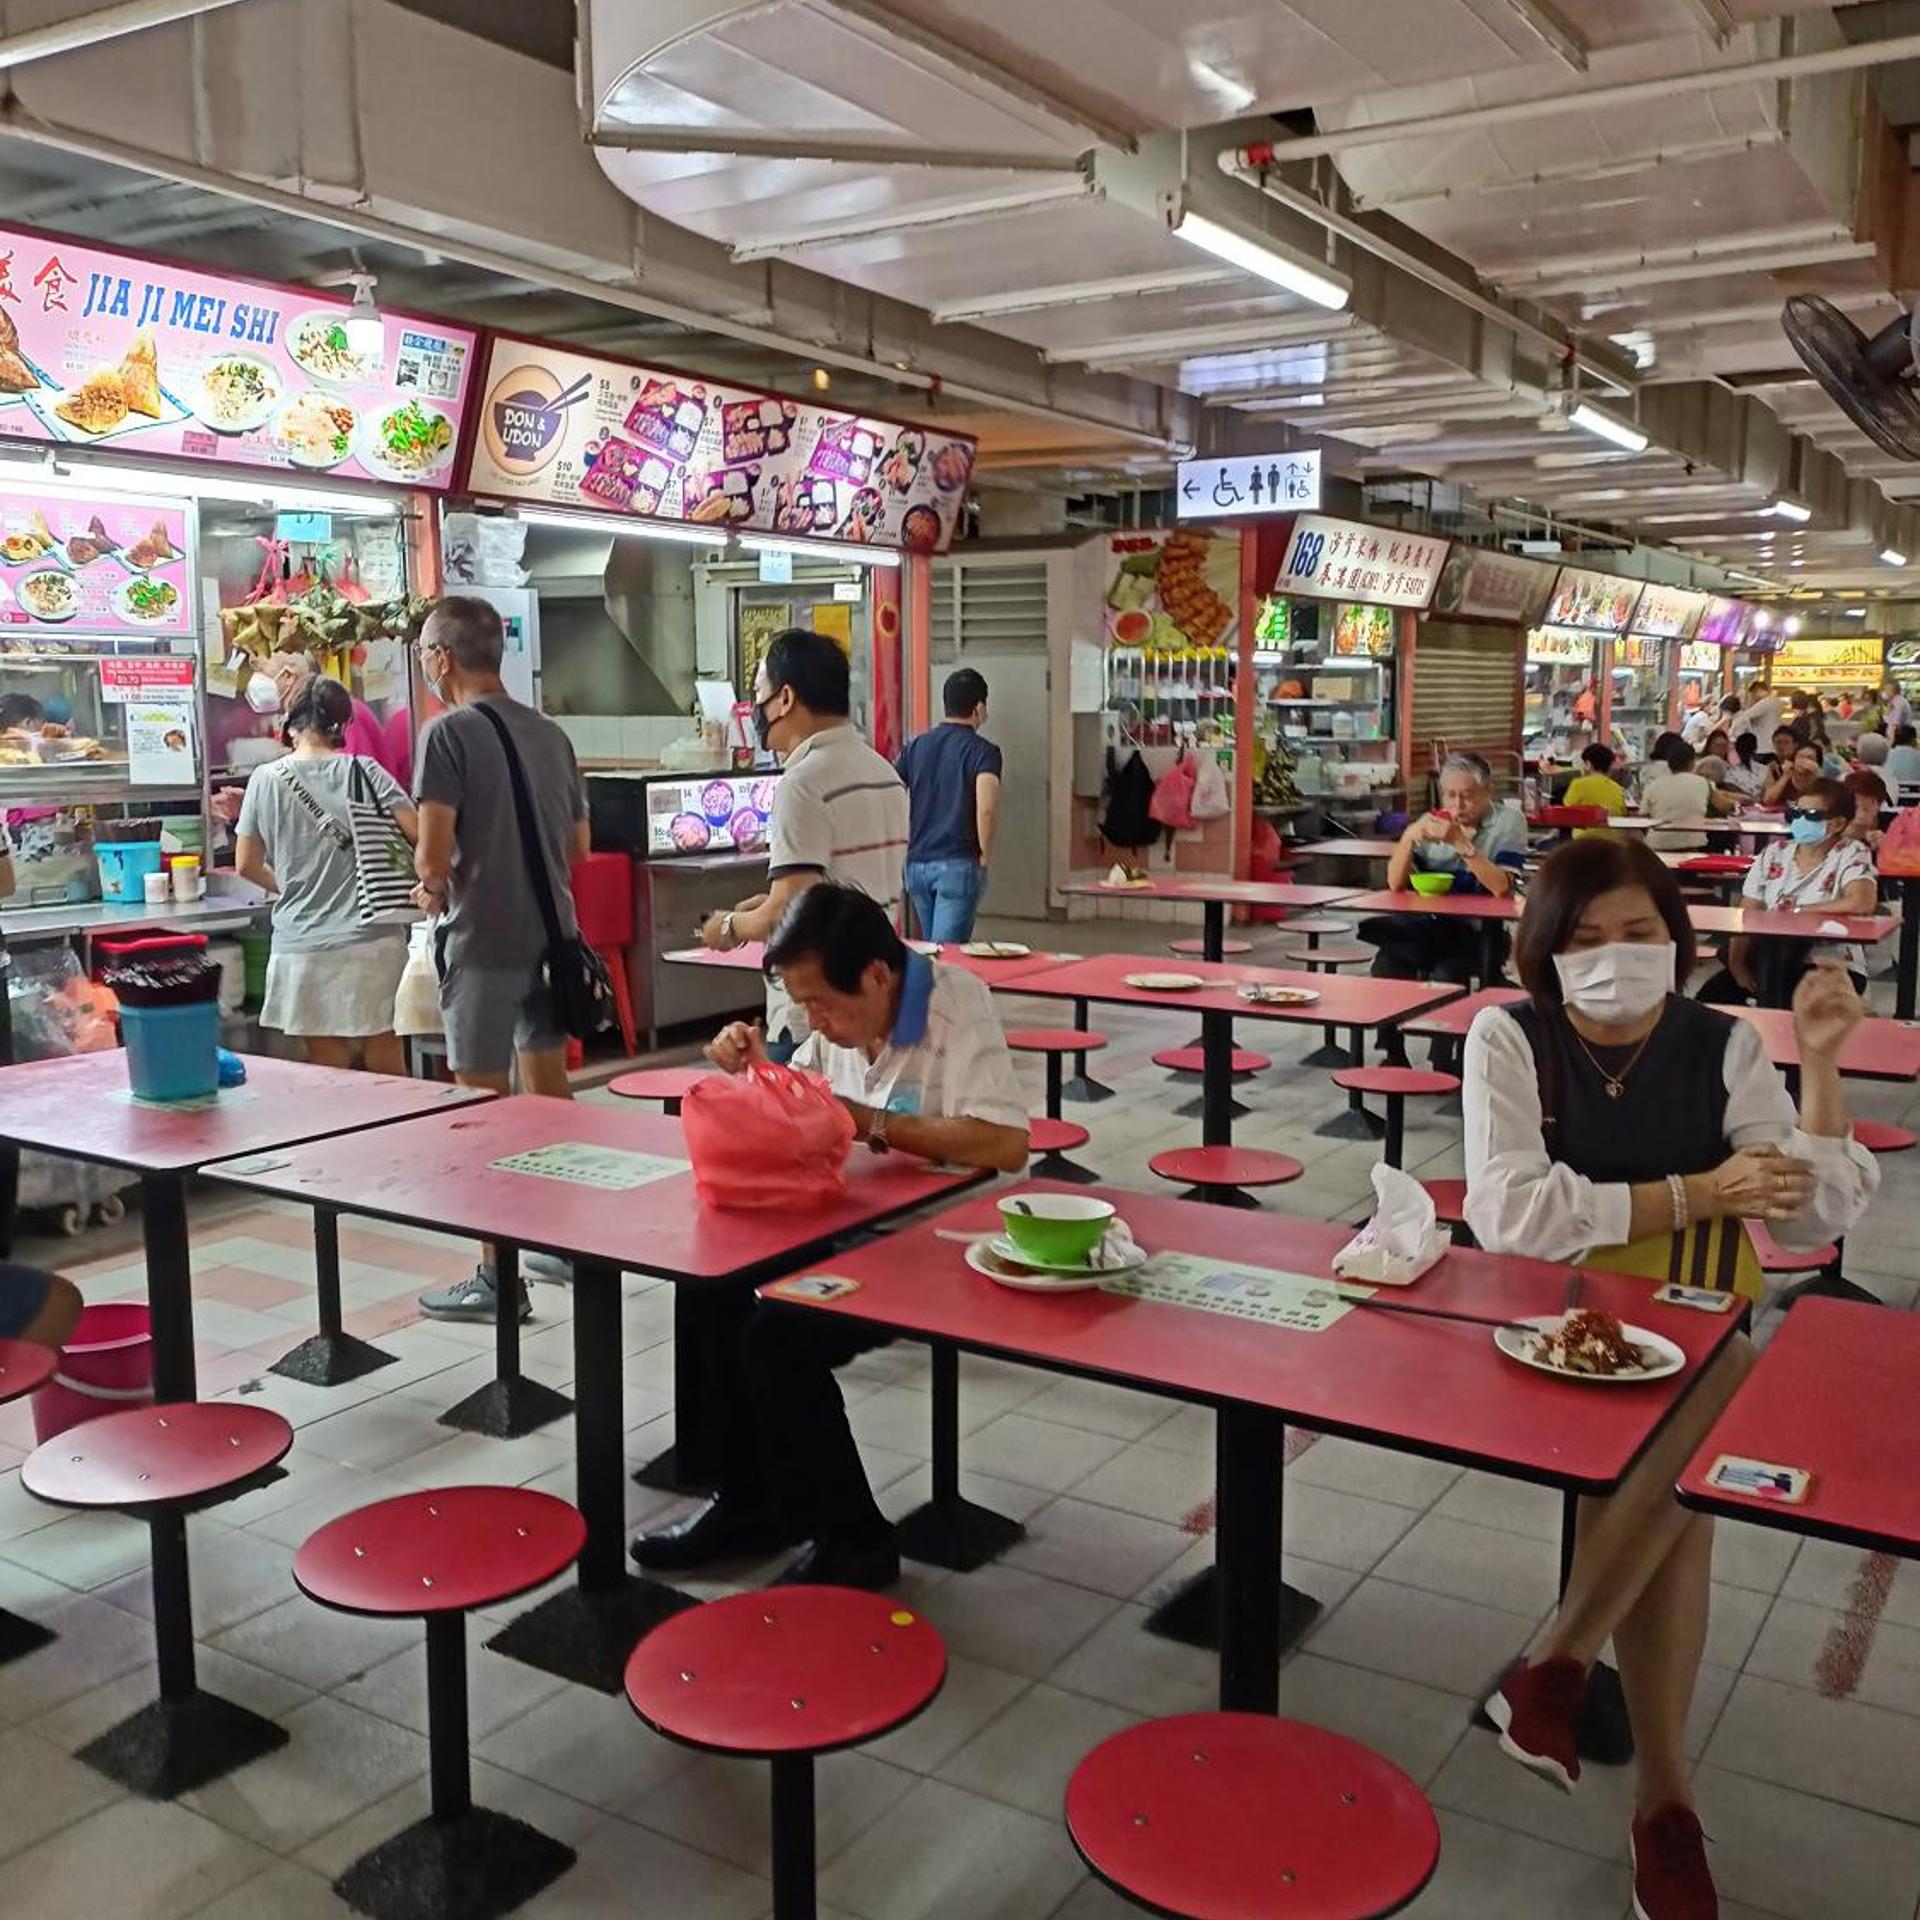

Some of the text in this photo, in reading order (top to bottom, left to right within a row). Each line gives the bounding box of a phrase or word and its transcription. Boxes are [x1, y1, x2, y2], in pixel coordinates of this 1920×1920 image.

[83, 273, 280, 344] JIA JI MEI SHI
[504, 408, 546, 430] DON &
[502, 428, 543, 448] UDON
[1287, 531, 1325, 578] 168
